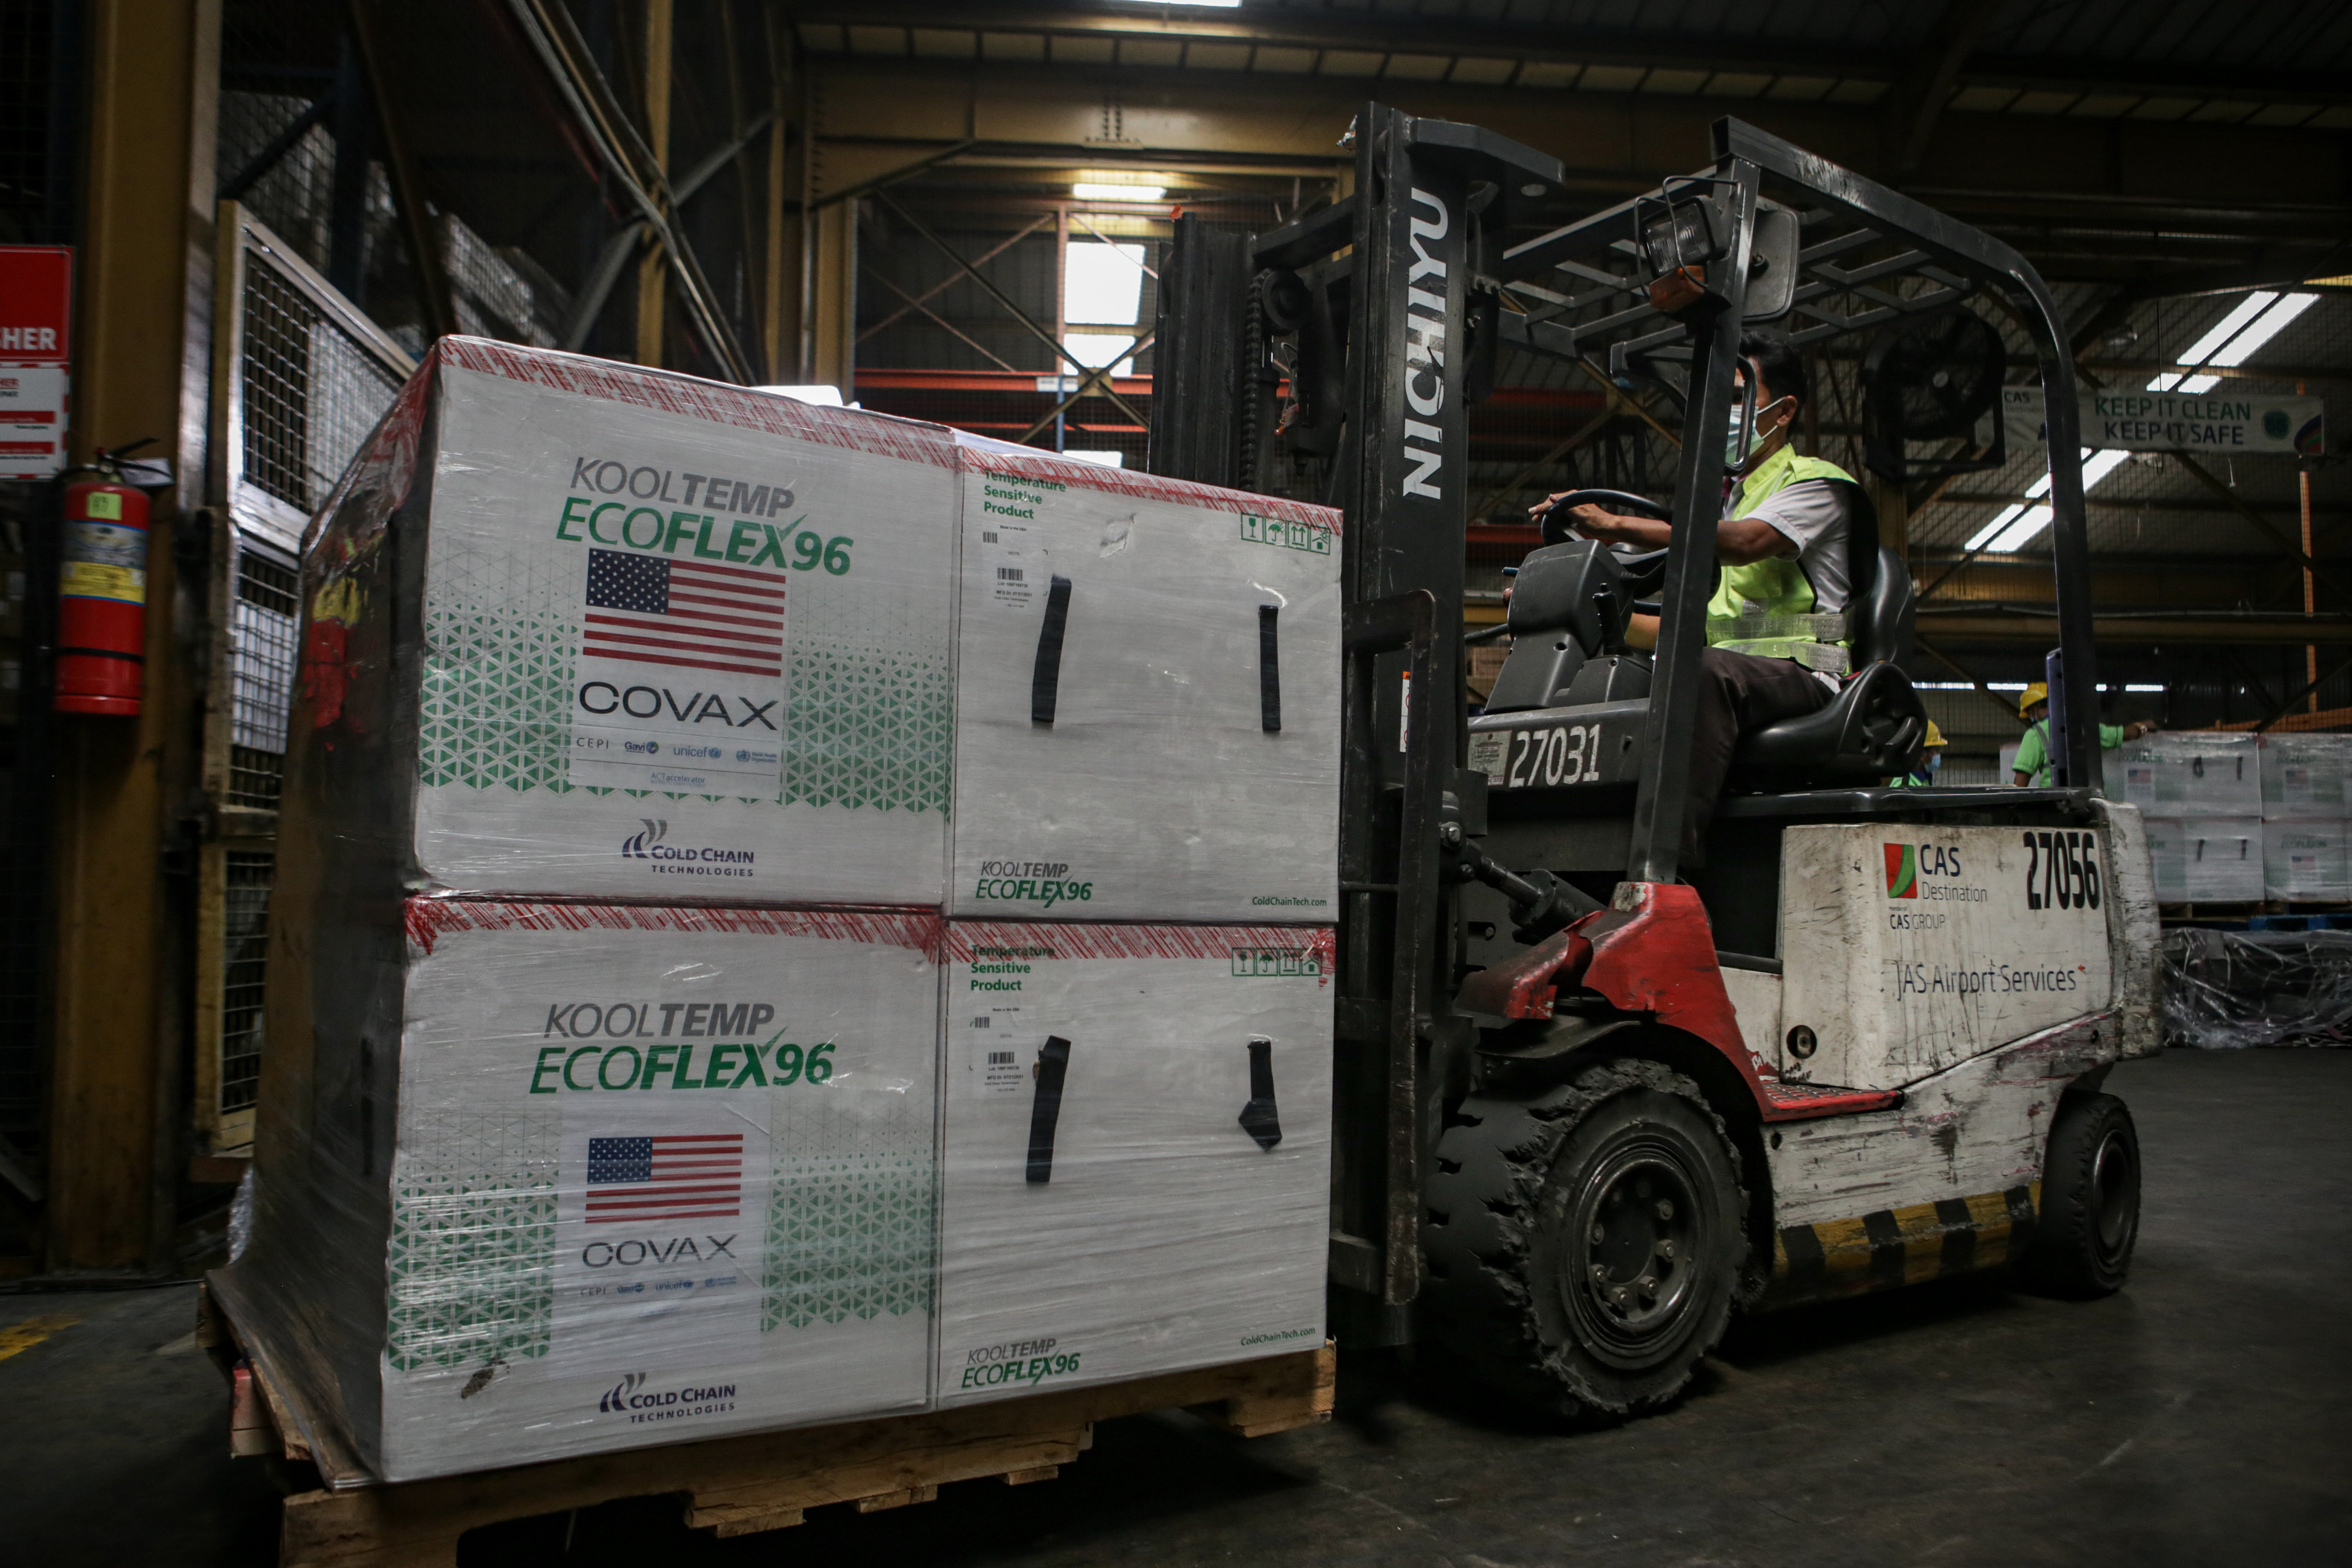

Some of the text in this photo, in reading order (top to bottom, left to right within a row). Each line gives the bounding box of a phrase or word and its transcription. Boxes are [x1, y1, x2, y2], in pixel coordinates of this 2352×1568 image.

[0, 327, 57, 350] HER
[1403, 187, 1448, 500] NICHIYU
[2004, 391, 2030, 403] CAS
[2094, 397, 2251, 421] KEEP IT CLEAN
[2104, 420, 2244, 445] KEEP IT SAFE
[570, 456, 795, 518] KOOLTEMP
[984, 468, 1067, 492] Temperature
[984, 485, 1043, 504] Sensitive
[984, 501, 1034, 519] Product
[579, 681, 779, 731] COVAX
[576, 737, 609, 750] CEPI
[624, 741, 646, 752] Gavi
[673, 746, 707, 758] unicef
[1509, 724, 1601, 788] 27031
[651, 845, 754, 864] COLD CHAIN
[1920, 844, 1961, 877] CAS
[652, 865, 754, 877] TECHNOLOGIES
[980, 861, 1069, 878] KOOLTEMP
[2023, 831, 2100, 910] 27056
[1252, 896, 1327, 906] ColdChainTech.com
[1922, 881, 1987, 902] Destination
[1890, 914, 1945, 930] CAS GROUP
[971, 944, 1055, 958] Temperature
[971, 961, 1031, 974] Sensitive
[971, 979, 1023, 991] Product
[1892, 960, 2076, 1001] JAS Airport Services
[543, 1003, 774, 1039] KOOLTEMP
[582, 1234, 737, 1268] COVAX
[655, 1281, 683, 1291] unicef
[1241, 1327, 1316, 1346] ColdChainTech.com
[967, 1338, 1057, 1365] KOOLTEMP
[630, 1385, 736, 1409] COLD CHAIN
[630, 1402, 735, 1424] TECHNOLOGIES
